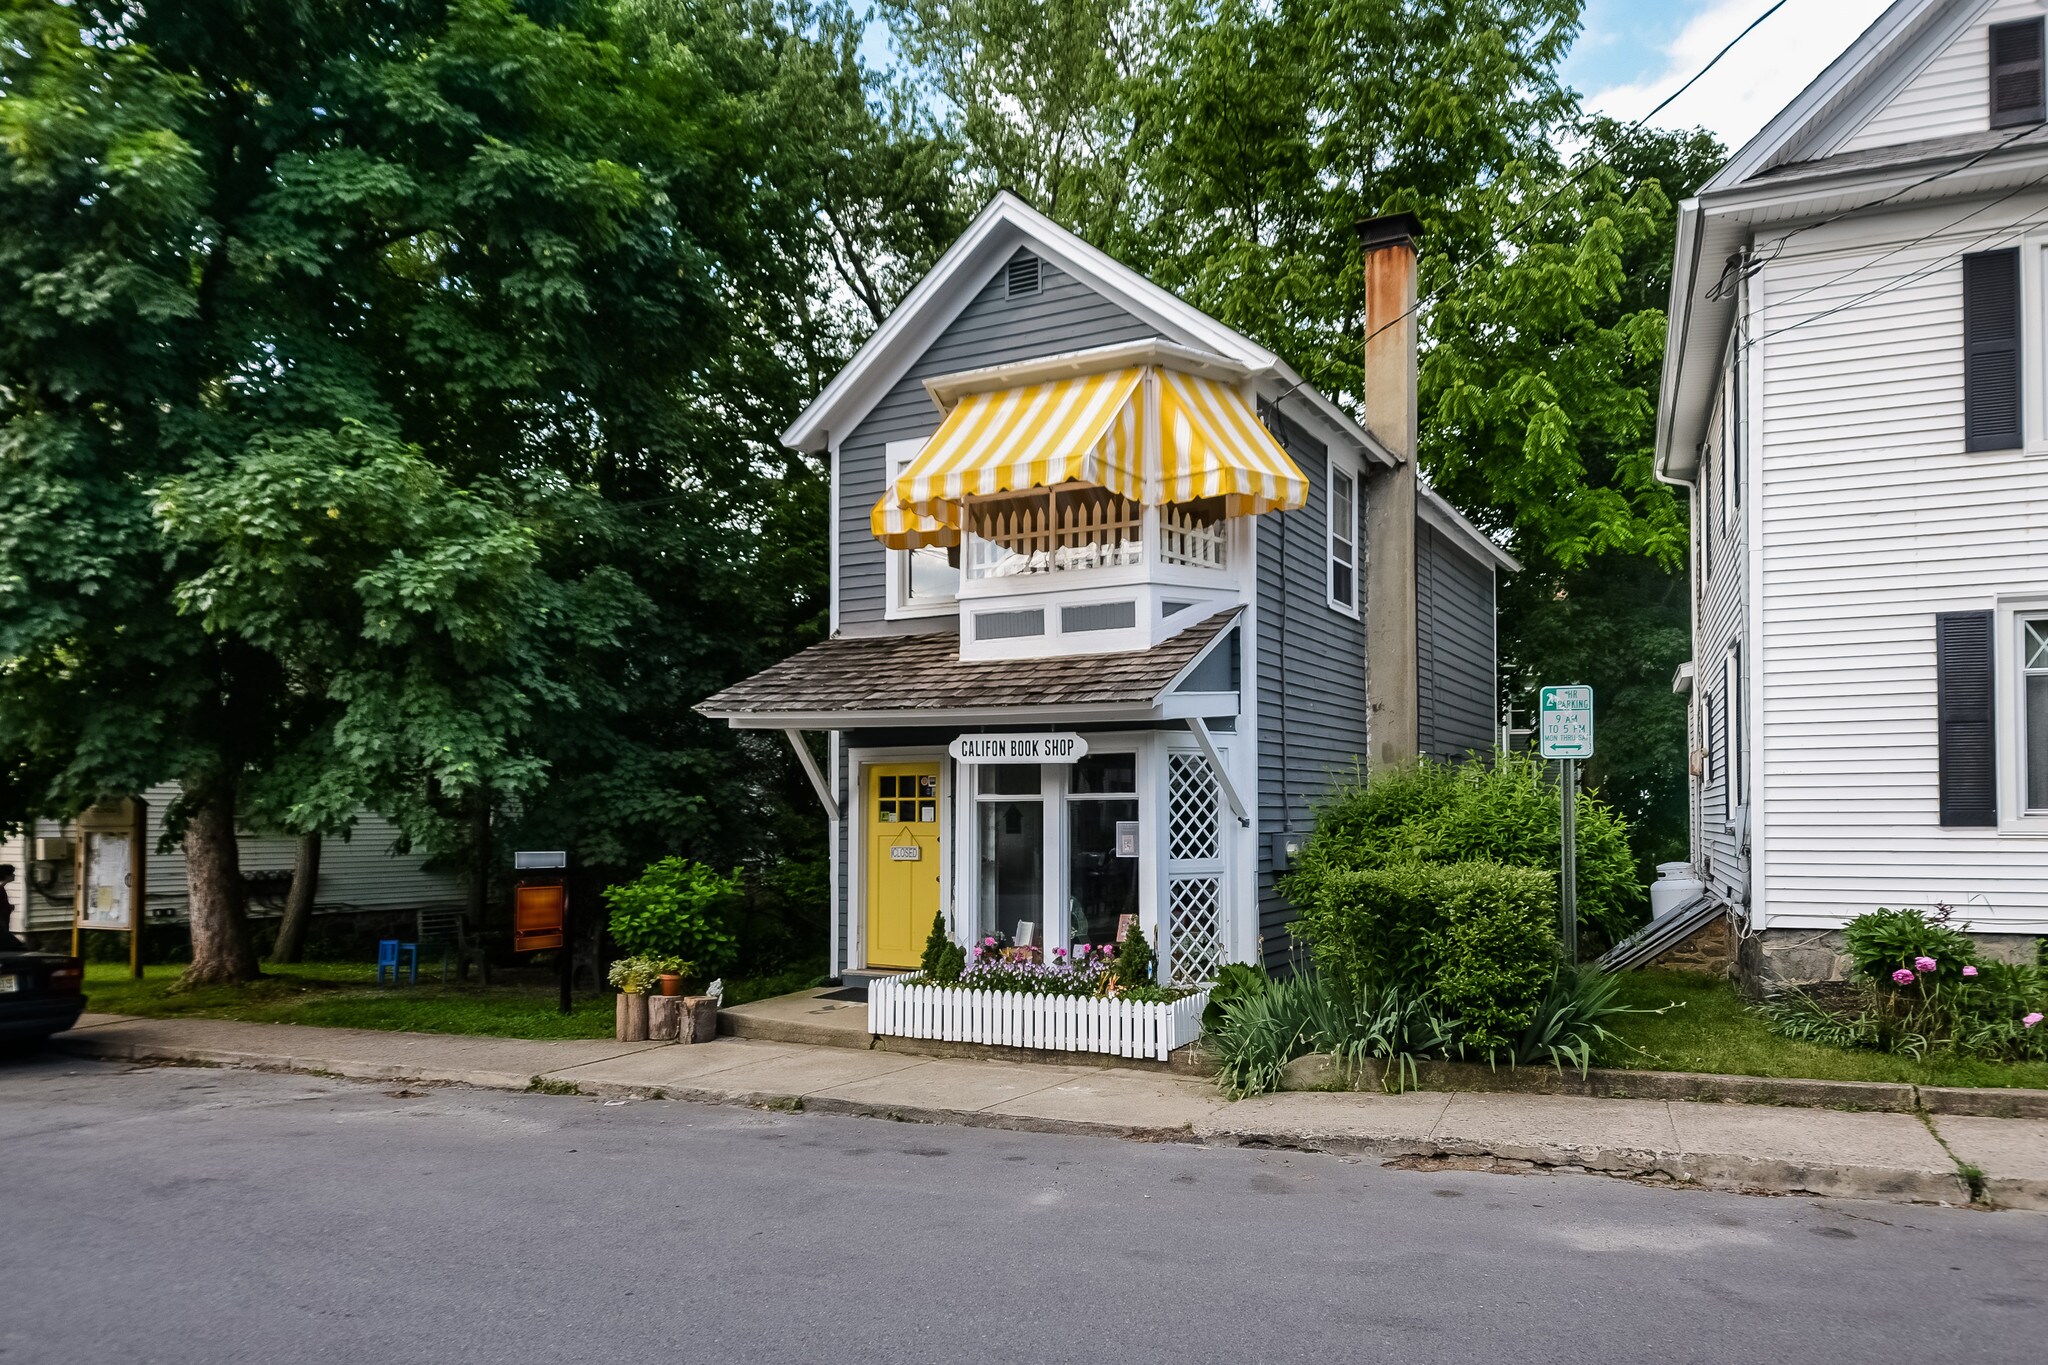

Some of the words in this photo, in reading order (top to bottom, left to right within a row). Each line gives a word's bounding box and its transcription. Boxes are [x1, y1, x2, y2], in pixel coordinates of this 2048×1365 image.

[1546, 693, 1555, 706] 2
[1567, 690, 1578, 698] HR
[1557, 699, 1589, 709] PARKING
[1556, 714, 1562, 723] 9
[1549, 725, 1559, 733] TO
[1563, 725, 1569, 733] 5
[961, 740, 1006, 757] CALIFON
[1011, 740, 1039, 756] BOOK
[1044, 739, 1074, 756] SHOP
[892, 847, 918, 858] CLOSED
